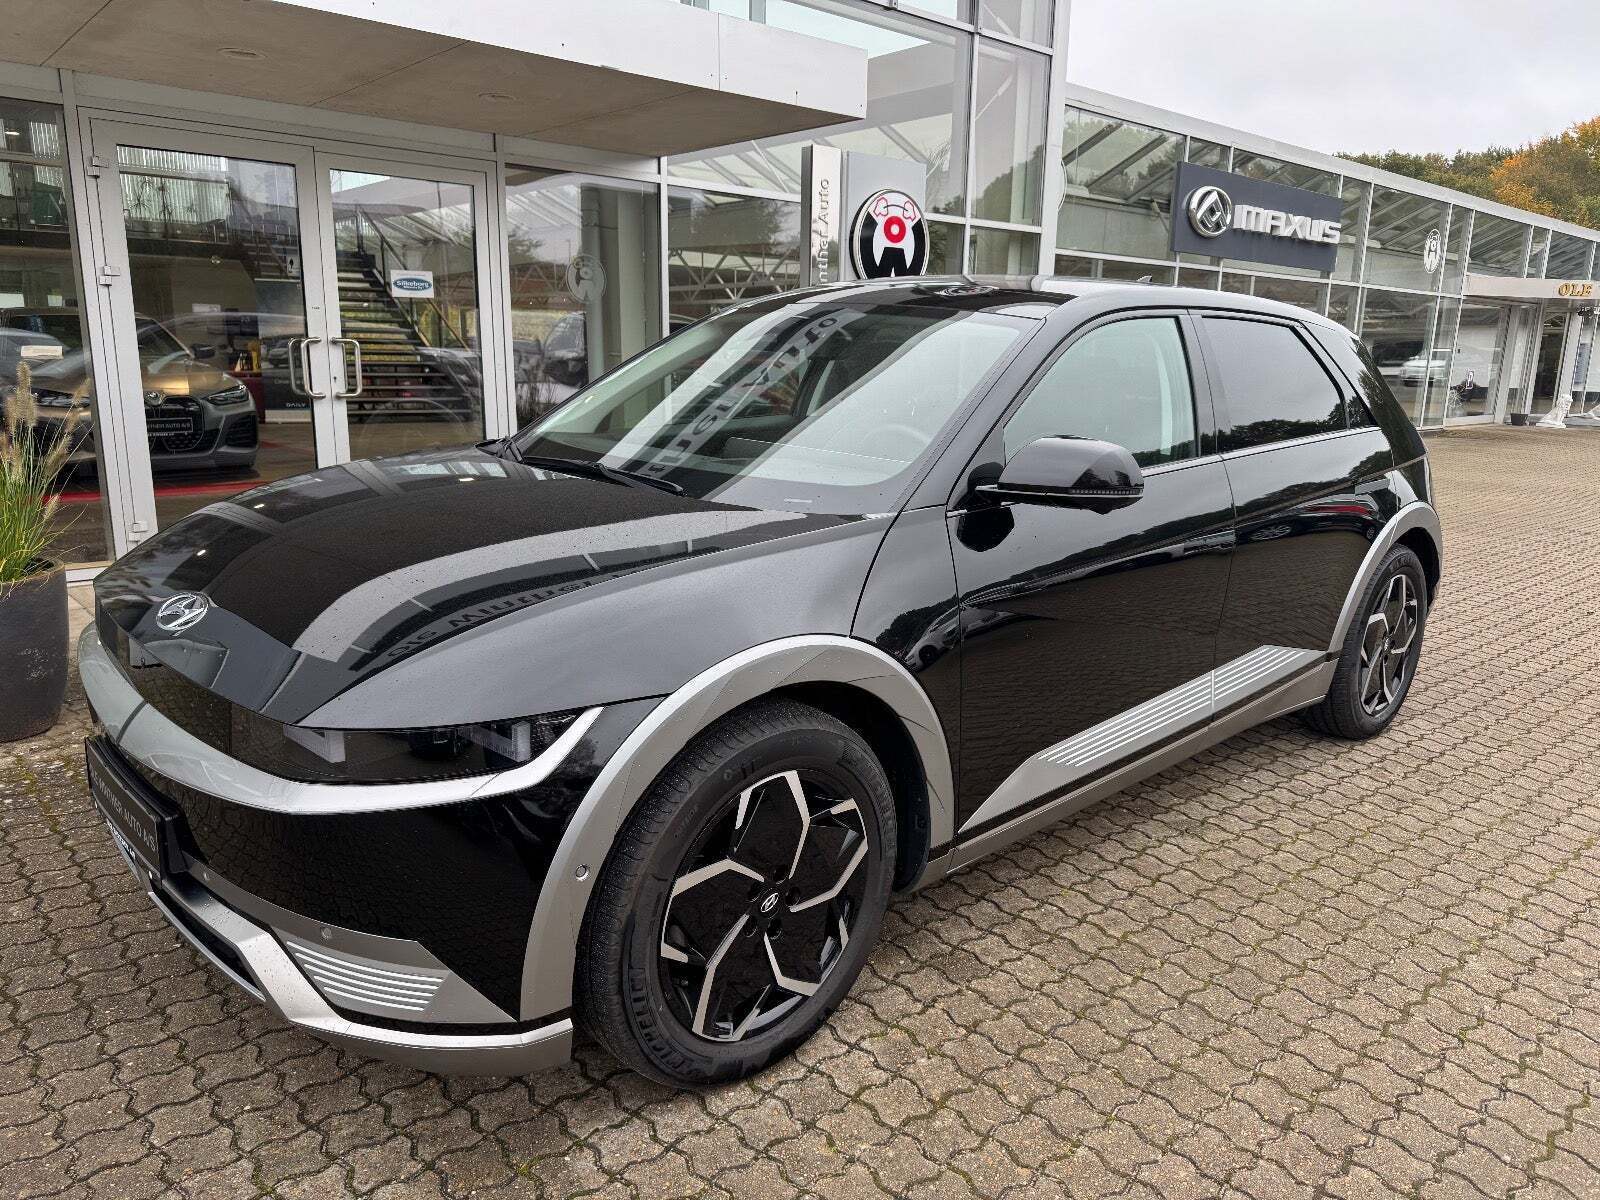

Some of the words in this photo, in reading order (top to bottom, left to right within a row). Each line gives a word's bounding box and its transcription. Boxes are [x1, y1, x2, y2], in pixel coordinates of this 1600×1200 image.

[817, 178, 829, 225] Auto
[1233, 204, 1342, 245] MAXUS
[1558, 282, 1592, 296] OLE
[124, 808, 142, 838] AUTO
